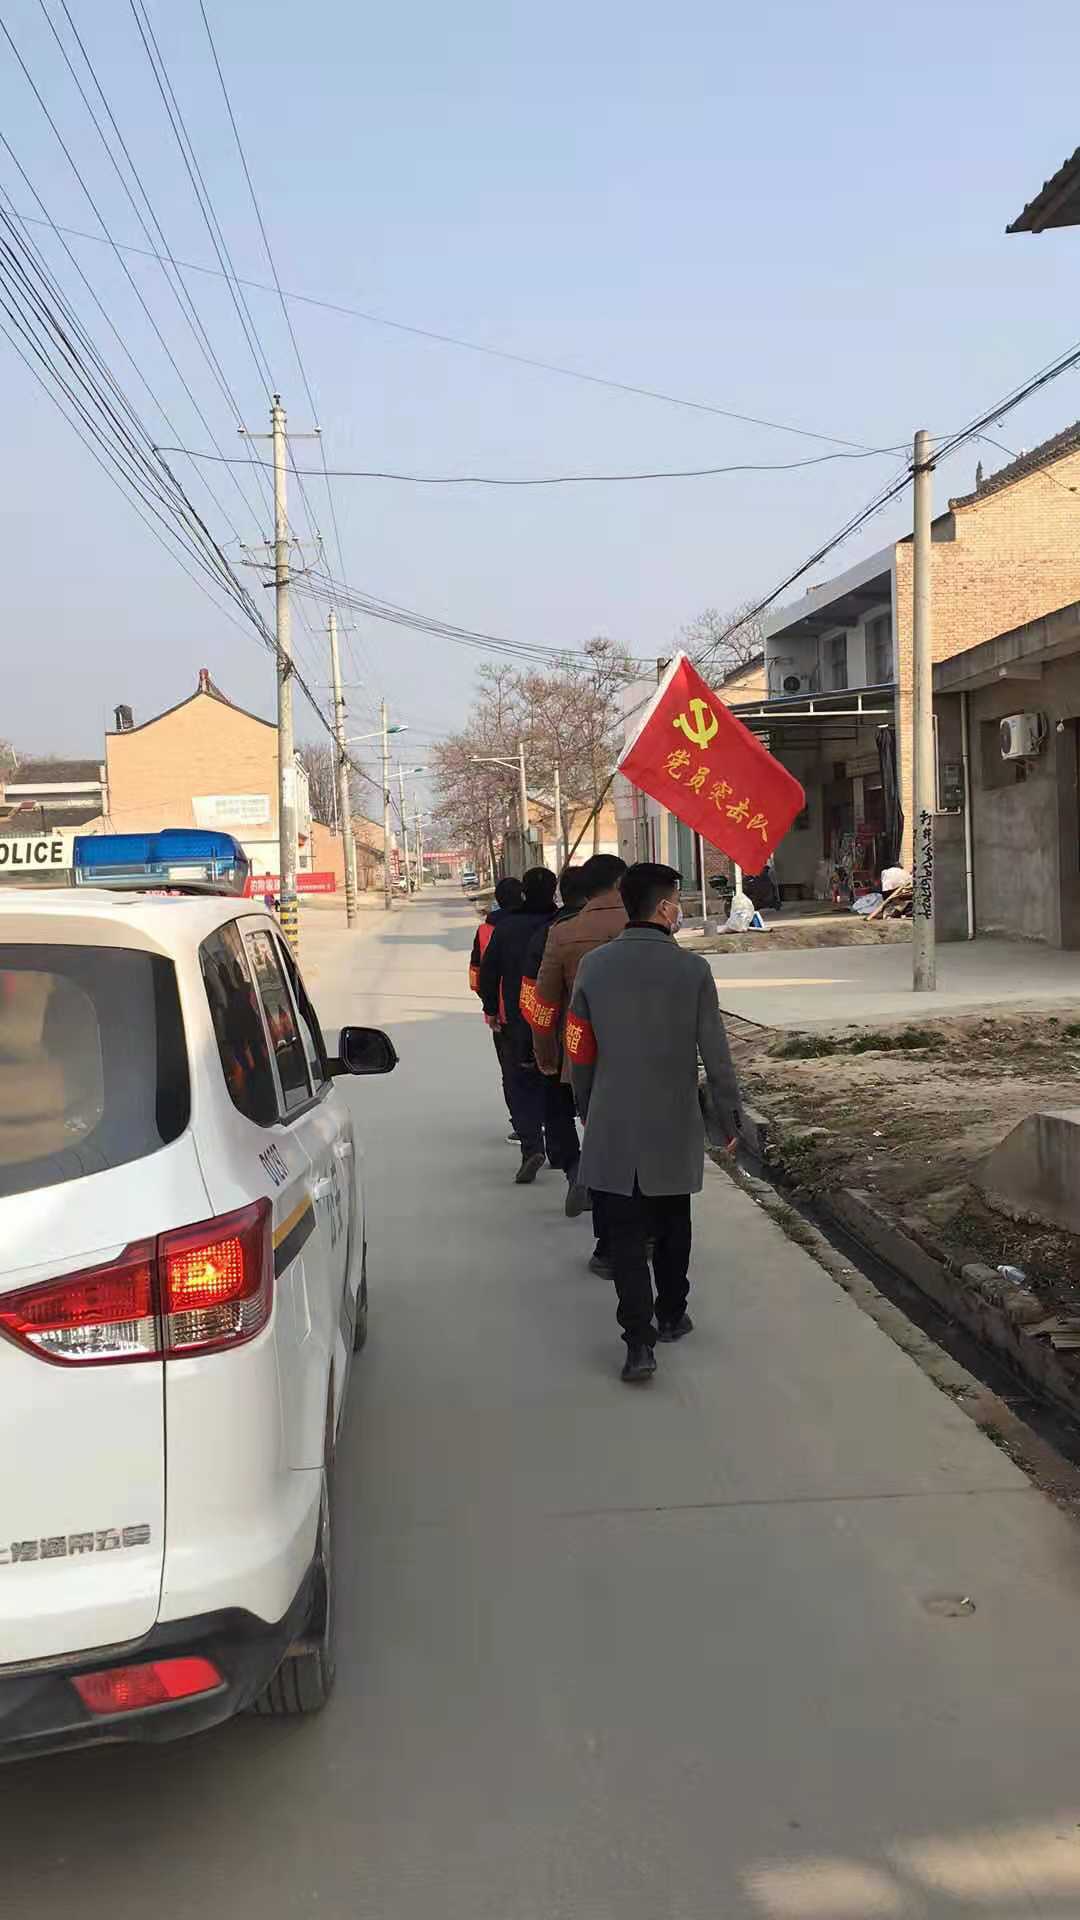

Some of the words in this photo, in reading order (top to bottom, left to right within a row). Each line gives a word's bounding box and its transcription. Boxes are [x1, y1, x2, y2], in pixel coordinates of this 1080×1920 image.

[663, 749, 768, 842] 党员突击队
